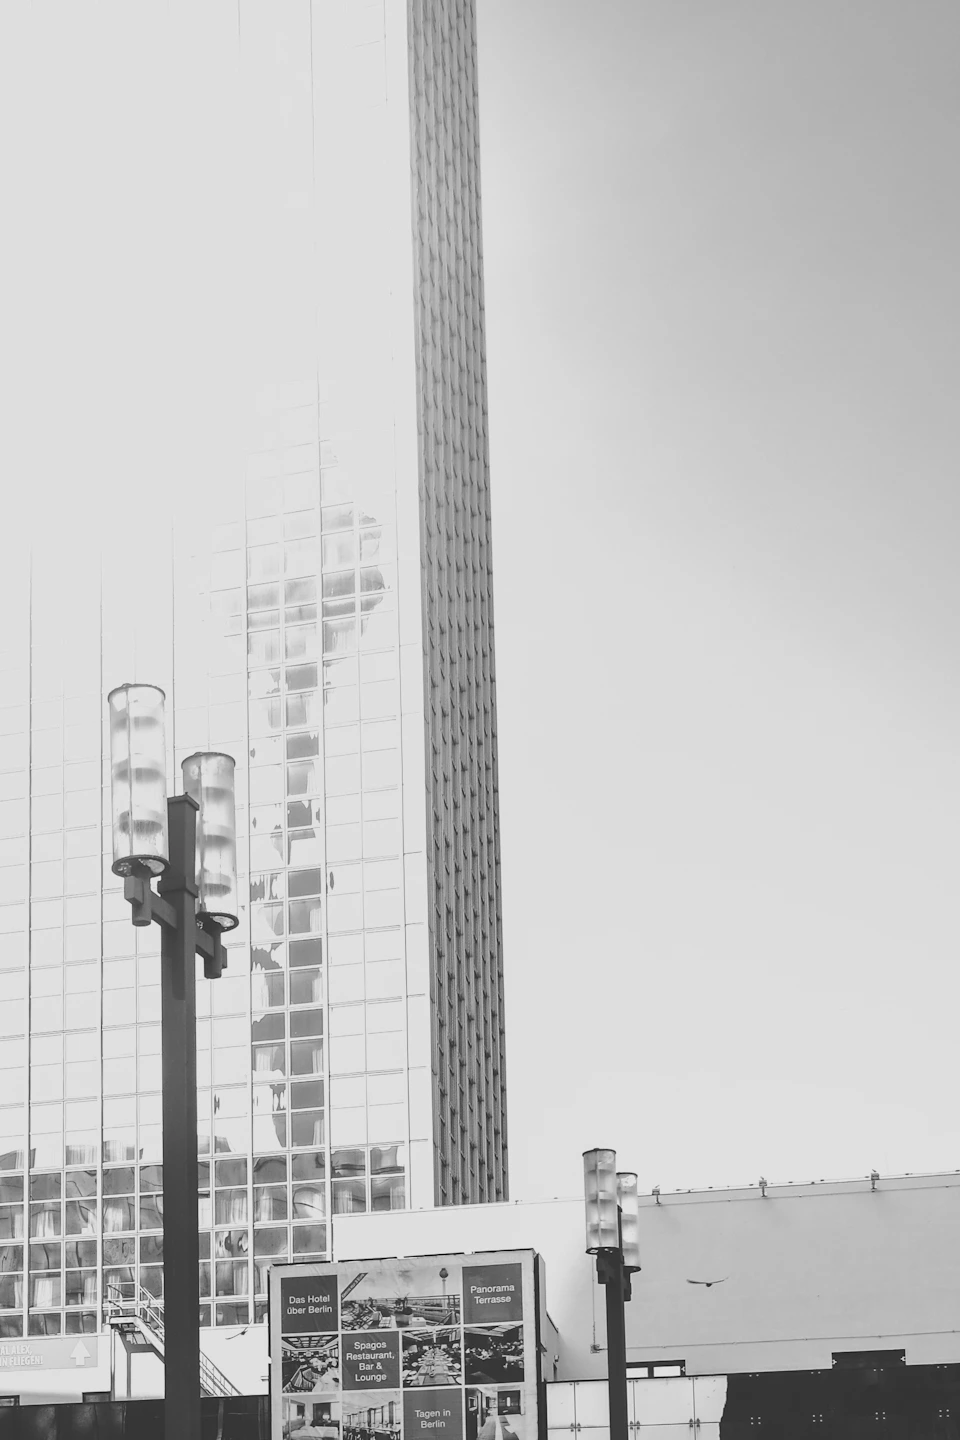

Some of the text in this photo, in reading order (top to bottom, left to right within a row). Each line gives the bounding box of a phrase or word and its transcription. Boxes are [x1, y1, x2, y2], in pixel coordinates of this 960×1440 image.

[470, 1284, 515, 1294] Panorama
[289, 1294, 330, 1304] Das Hotel
[474, 1296, 512, 1304] Terrasse
[286, 1305, 333, 1315] über Berlin
[11, 1344, 32, 1356] ALEX,
[354, 1341, 387, 1351] Spagos
[9, 1355, 44, 1366] FLIEGEN!
[346, 1351, 395, 1361] Restaurant,
[359, 1362, 383, 1371] Bar &
[355, 1373, 387, 1383] Lounge
[414, 1408, 451, 1419] Tagen in
[420, 1420, 446, 1429] Berlin
